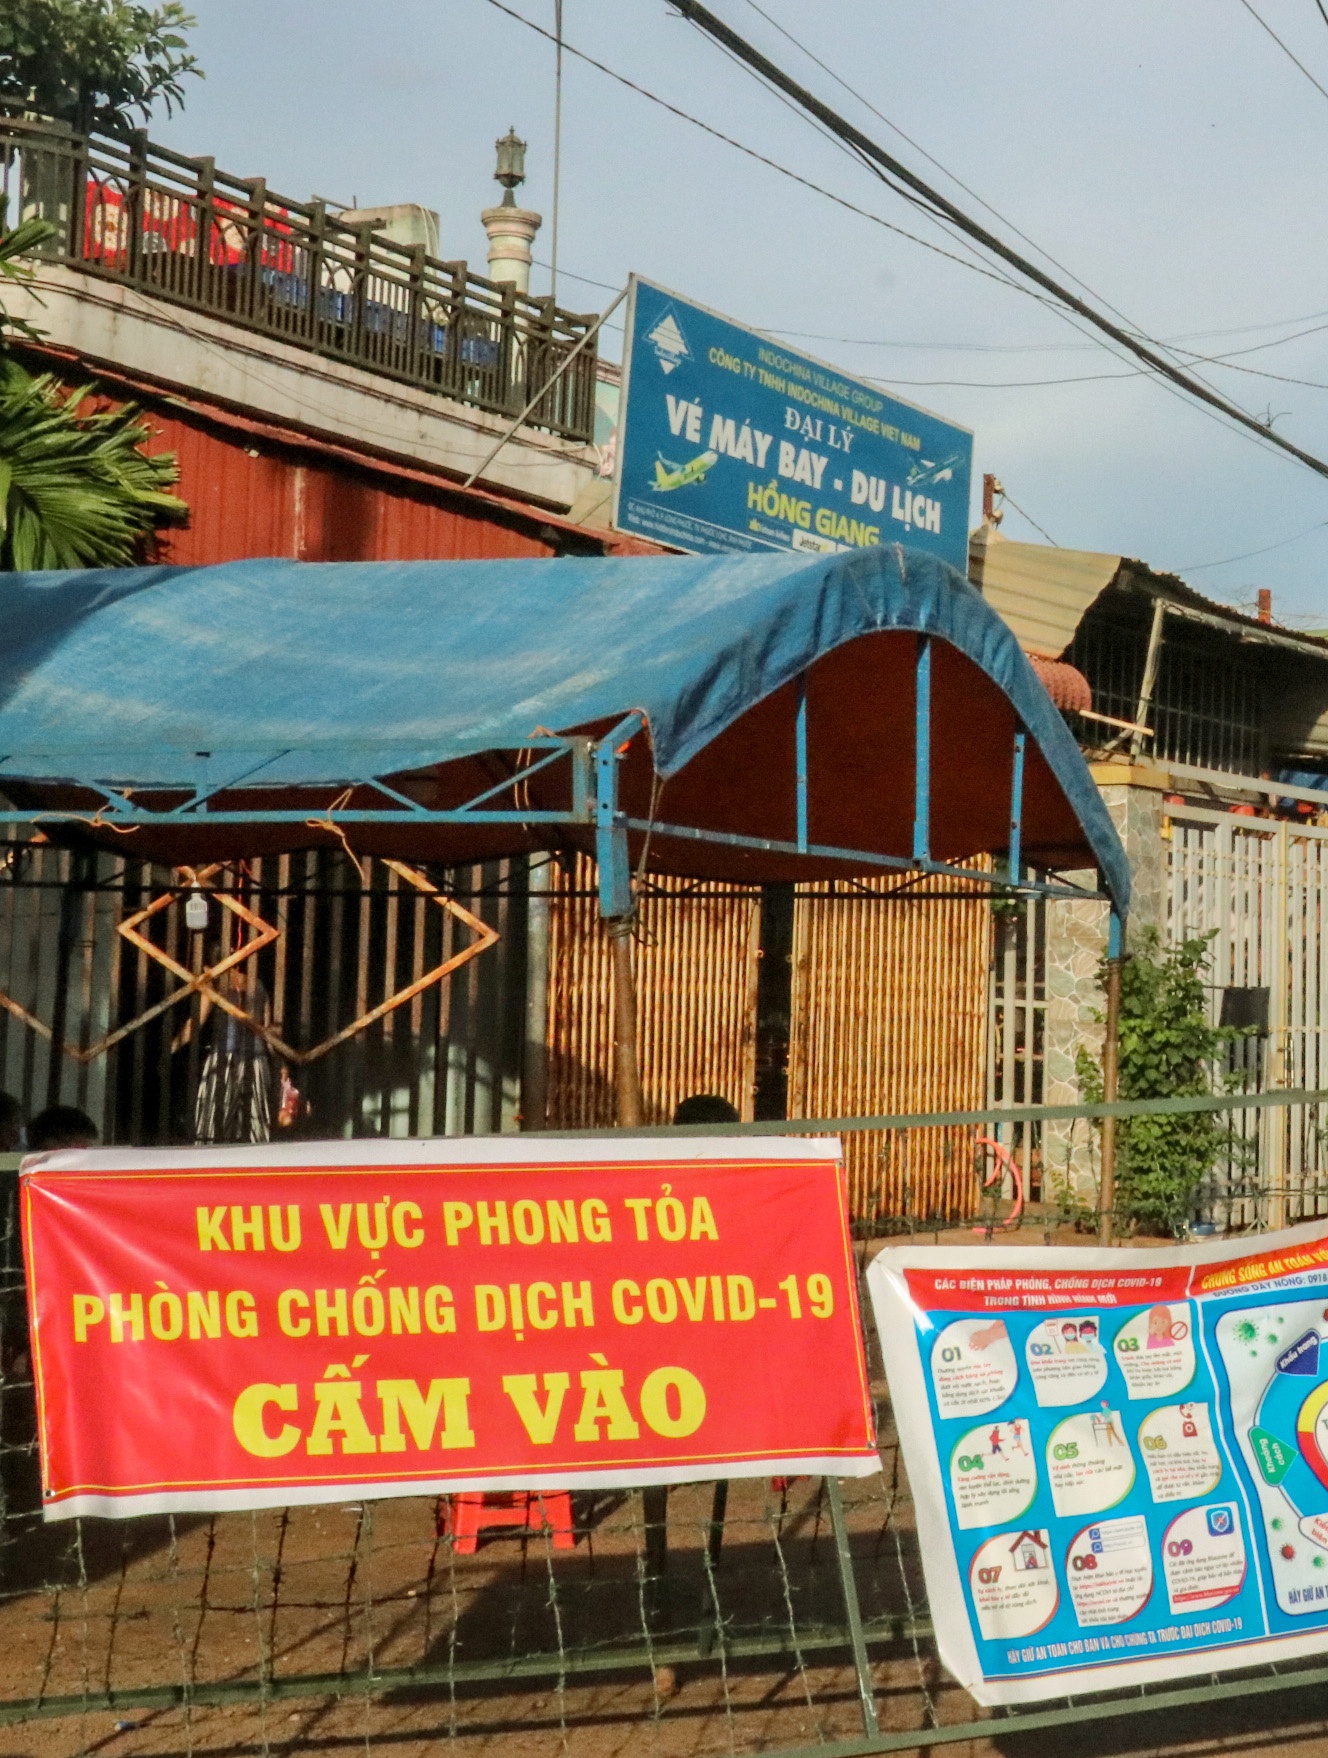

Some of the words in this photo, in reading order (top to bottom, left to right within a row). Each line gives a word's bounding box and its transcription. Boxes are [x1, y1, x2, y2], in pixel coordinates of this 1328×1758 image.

[758, 347, 811, 380] INDOCHINA
[811, 370, 850, 400] VILLAGE
[851, 390, 884, 413] GROUP
[708, 347, 741, 374] CÔNG
[743, 361, 755, 381] TY
[759, 369, 786, 395] TNHH
[787, 380, 840, 417] INDOCHINA
[841, 404, 881, 435] VILLAGE
[901, 431, 921, 451] NAM
[784, 406, 823, 442] ĐẠI
[828, 424, 855, 454] LÝ
[665, 394, 703, 444] VÉ
[709, 413, 773, 469] MÁY
[778, 440, 829, 490] BAY
[851, 469, 887, 513] DU
[892, 484, 941, 534] LỊCH
[747, 478, 811, 529] HỒNG
[815, 507, 880, 547] GIANG
[195, 1205, 301, 1253] KHU
[320, 1195, 426, 1259] VỰC
[444, 1198, 611, 1249] PHONG
[624, 1183, 719, 1244] TỎA
[934, 1276, 957, 1290] CÁC
[986, 1276, 1013, 1290] PHÁP
[1054, 1275, 1089, 1290] CHỐNG
[1091, 1277, 1114, 1291] DỊCH
[1117, 1276, 1162, 1289] COVID-19
[1201, 1269, 1236, 1290] CHUNG
[1268, 1262, 1283, 1276] AN
[1308, 1272, 1328, 1284] 0918
[73, 1284, 259, 1343] PHÒNG
[277, 1269, 456, 1338] CHỐNG
[477, 1281, 595, 1341] DỊCH
[612, 1273, 835, 1327] COVID-19
[984, 1294, 1019, 1307] TRONG
[1097, 1291, 1118, 1304] MỚI
[941, 1345, 962, 1363] 01
[1030, 1343, 1054, 1356] 02
[1117, 1337, 1140, 1352] 03
[1297, 1335, 1319, 1357] trang
[232, 1354, 476, 1459] CẤM
[503, 1353, 707, 1447] VÀO
[1053, 1442, 1079, 1461] 05
[1143, 1434, 1167, 1450] 06
[958, 1454, 984, 1472] 04
[1272, 1442, 1286, 1466] cách
[1311, 1529, 1328, 1545] biên
[1167, 1539, 1193, 1557] 09
[1072, 1553, 1098, 1572] 08
[978, 1565, 1002, 1584] 07
[1315, 1585, 1325, 1600] AN
[1036, 1645, 1048, 1660] AN
[1068, 1640, 1085, 1655] CHO
[1212, 1617, 1243, 1633] COVID-19
